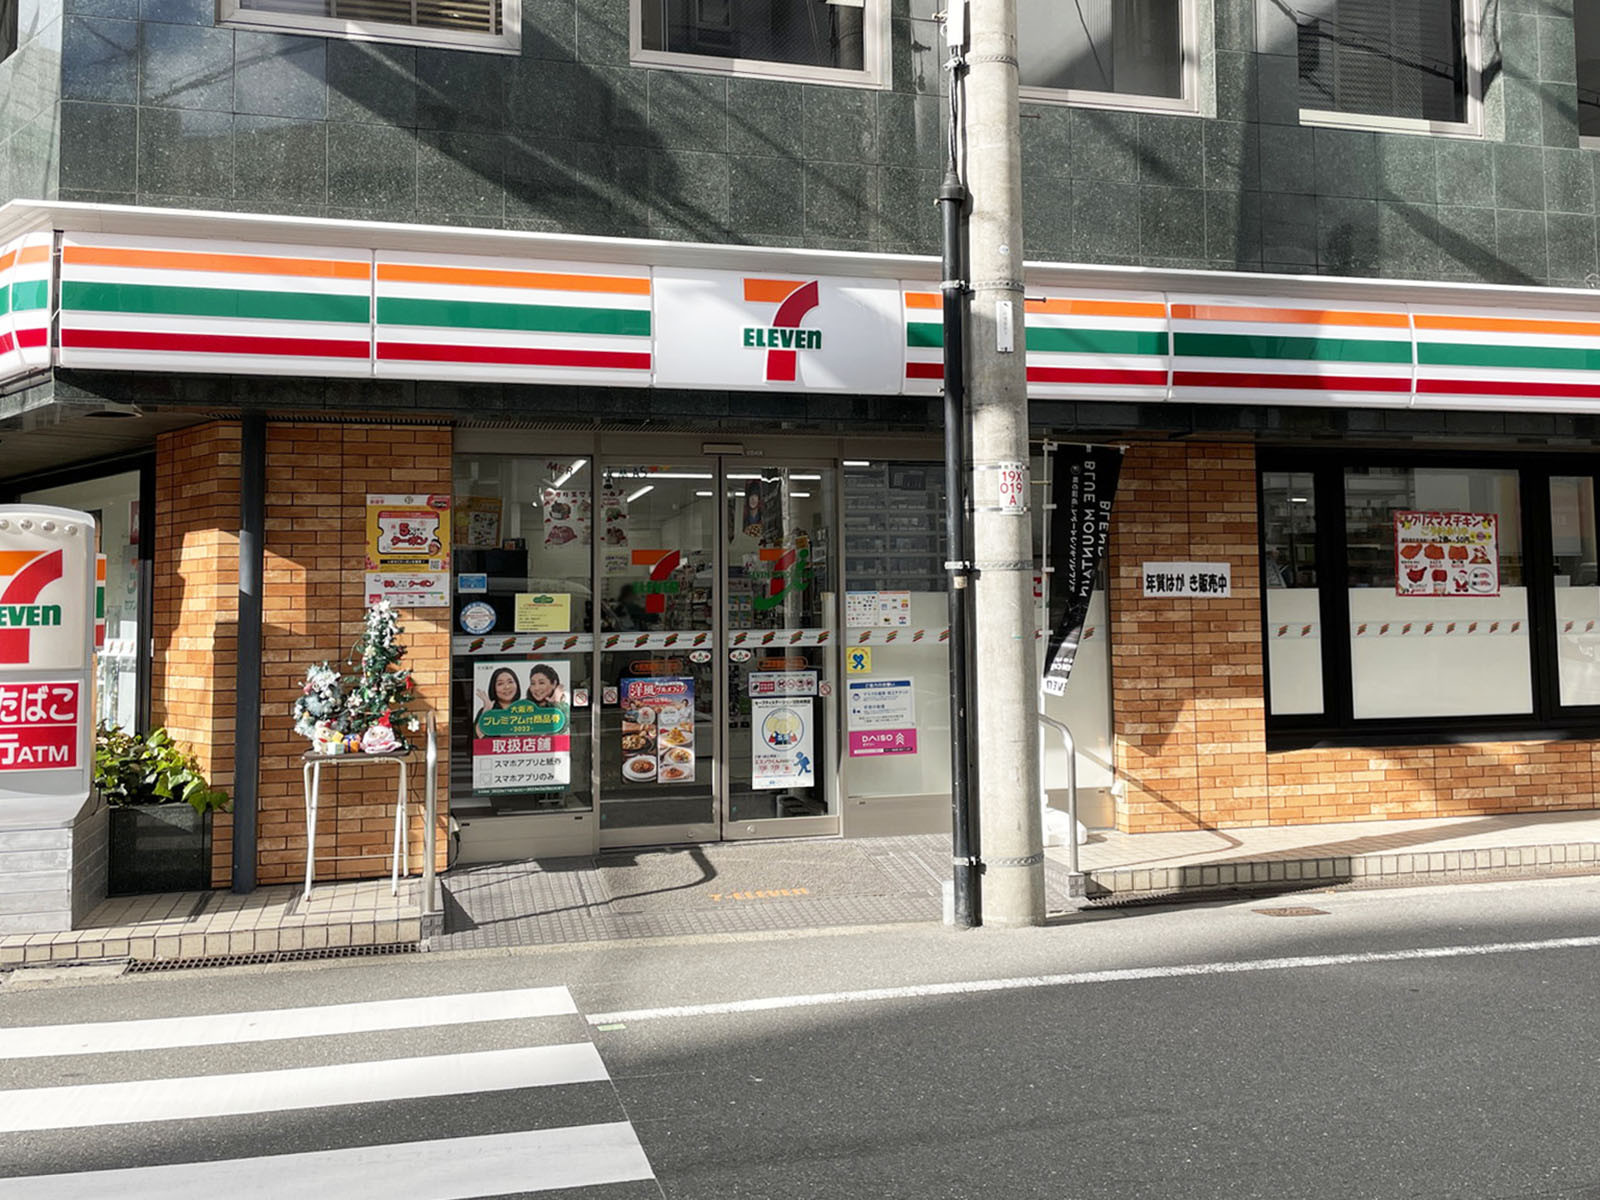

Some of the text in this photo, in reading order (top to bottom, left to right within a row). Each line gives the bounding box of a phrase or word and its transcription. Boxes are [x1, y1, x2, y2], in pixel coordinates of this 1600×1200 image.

[743, 278, 819, 381] 7
[1009, 494, 1017, 506] A
[1410, 515, 1482, 528] クリスマスチキン
[1146, 574, 1227, 593] 年賀はがき販売中
[483, 715, 561, 726] プレミアム付商品券
[492, 737, 552, 753] 取扱店舗
[494, 773, 555, 783] スマホアプリのみ
